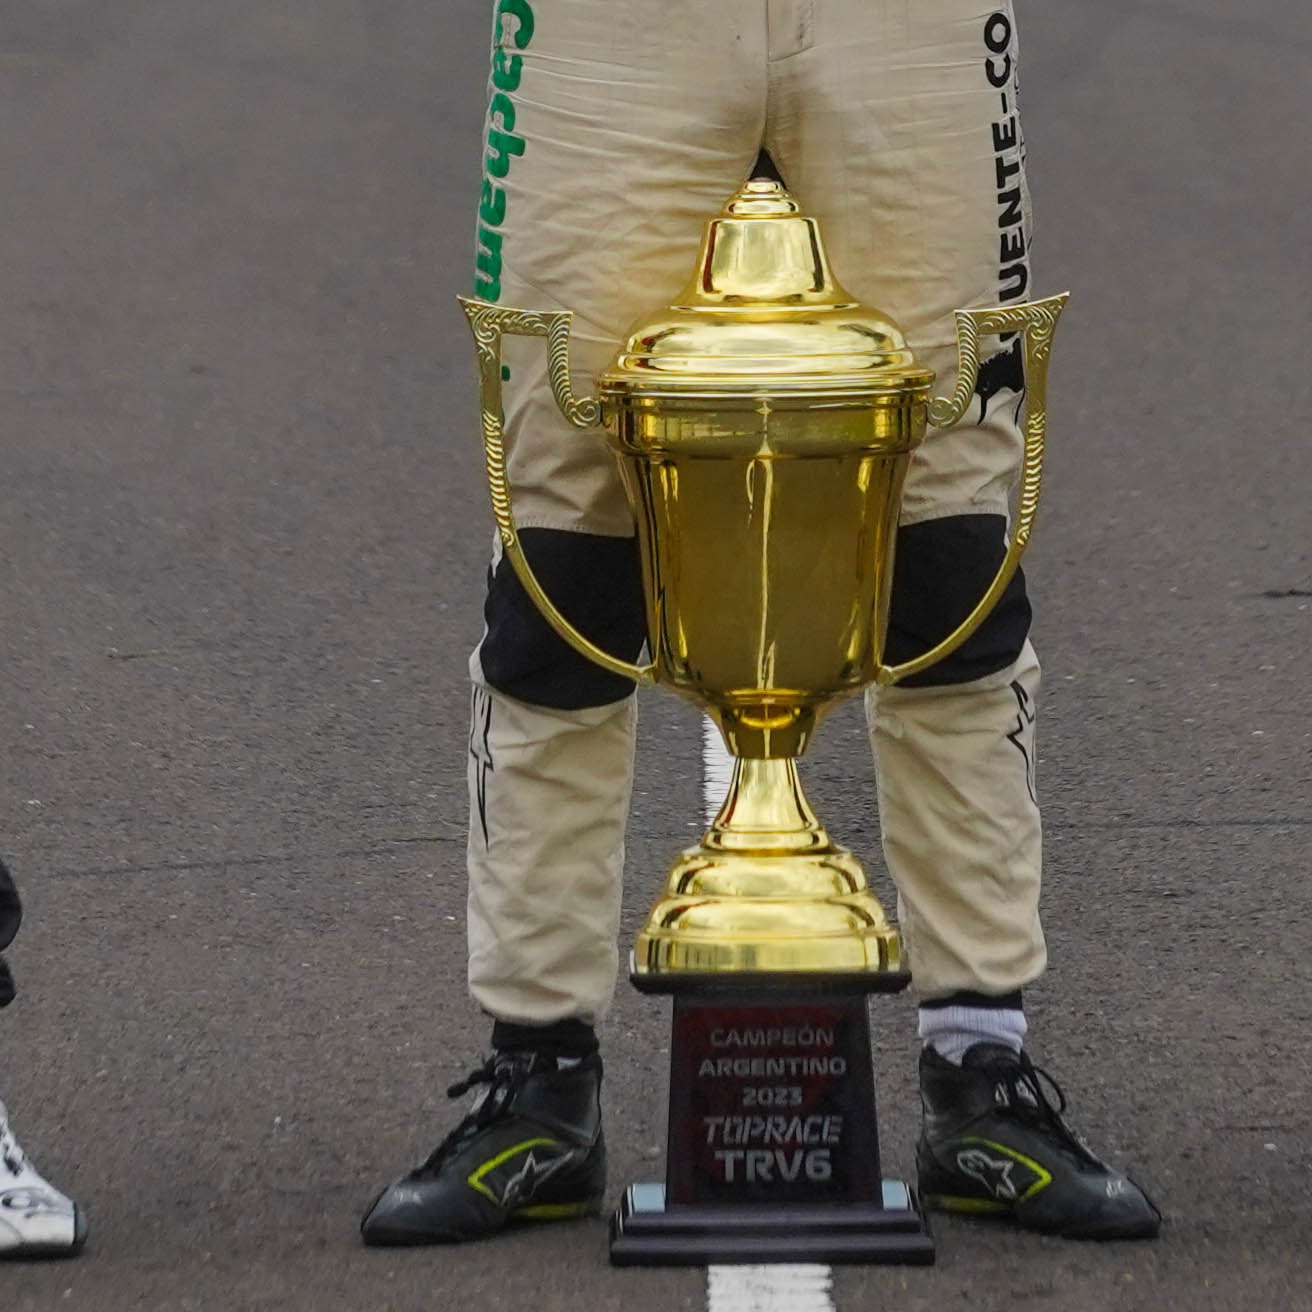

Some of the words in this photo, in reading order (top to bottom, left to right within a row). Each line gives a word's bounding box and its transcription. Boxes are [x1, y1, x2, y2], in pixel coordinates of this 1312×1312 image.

[984, 12, 1028, 304] UENTE-CO
[698, 1056, 846, 1077] ARGENTINO
[742, 1087, 802, 1106] 2023
[703, 1116, 843, 1143] TOPRACE
[714, 1149, 832, 1182] TRV6
